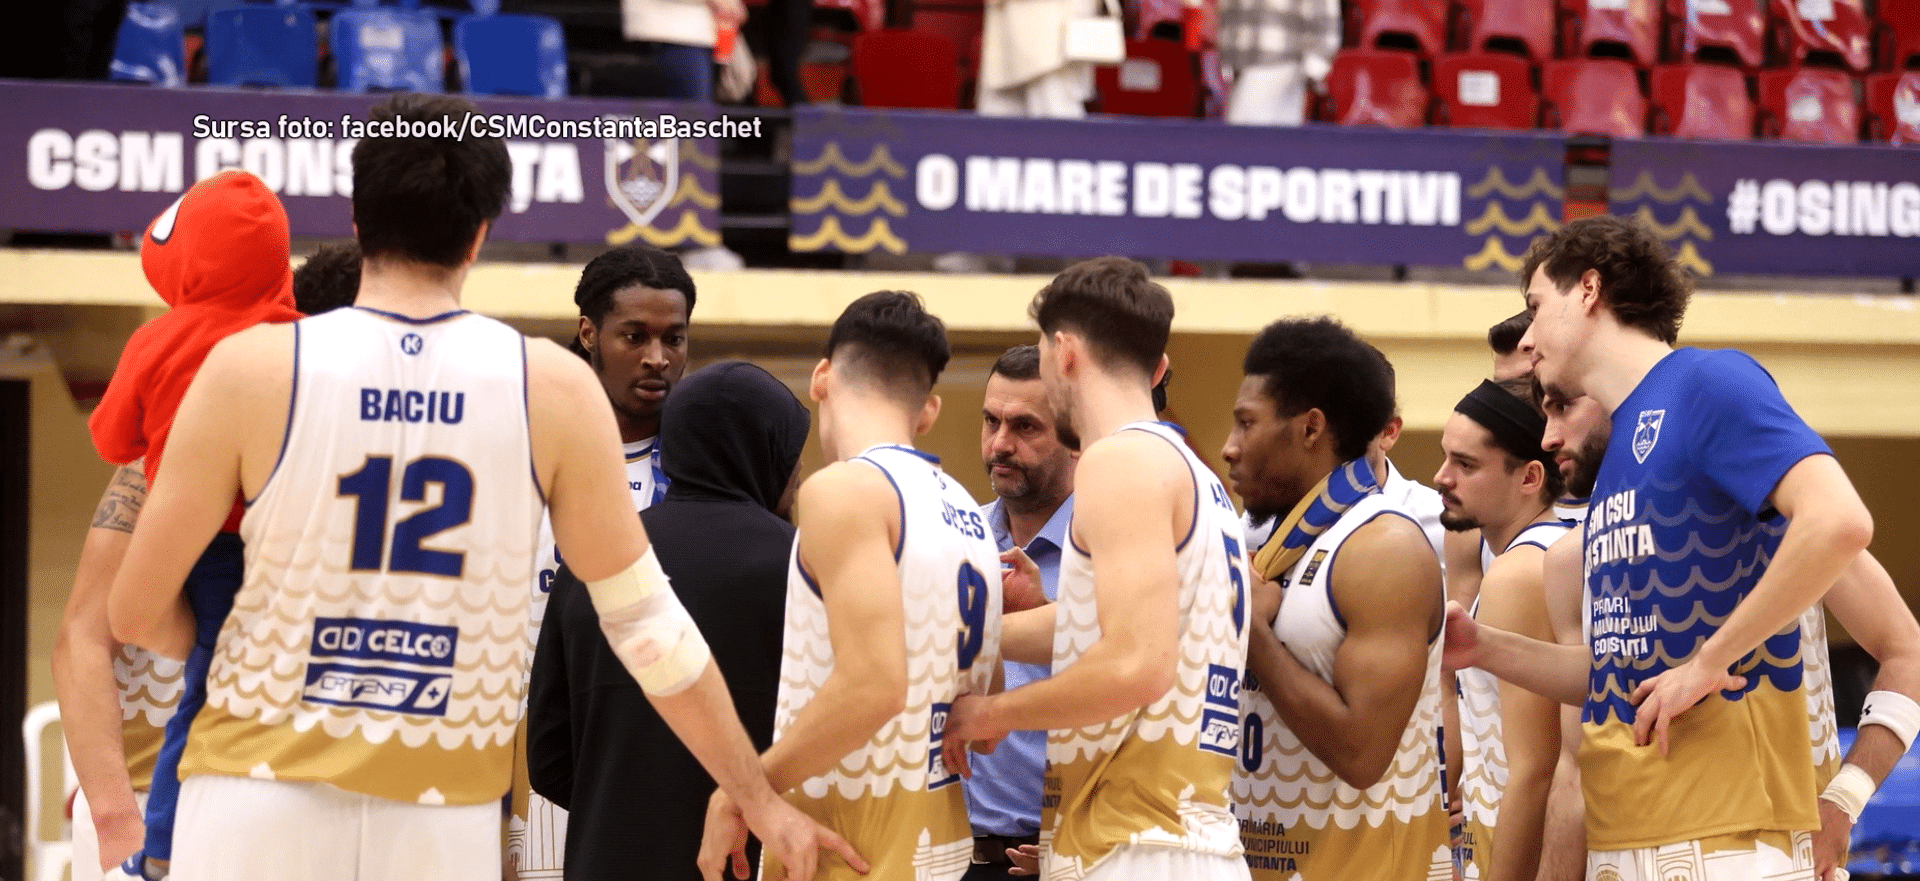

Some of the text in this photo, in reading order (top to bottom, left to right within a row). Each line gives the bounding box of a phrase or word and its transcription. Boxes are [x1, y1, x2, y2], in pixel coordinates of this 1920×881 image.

[27, 128, 184, 192] CSM
[916, 153, 1462, 226] O MARE DE SPORTIVI
[360, 387, 465, 425] BACIU
[336, 454, 476, 580] 12
[1606, 489, 1636, 526] CSU
[957, 560, 990, 670] 9
